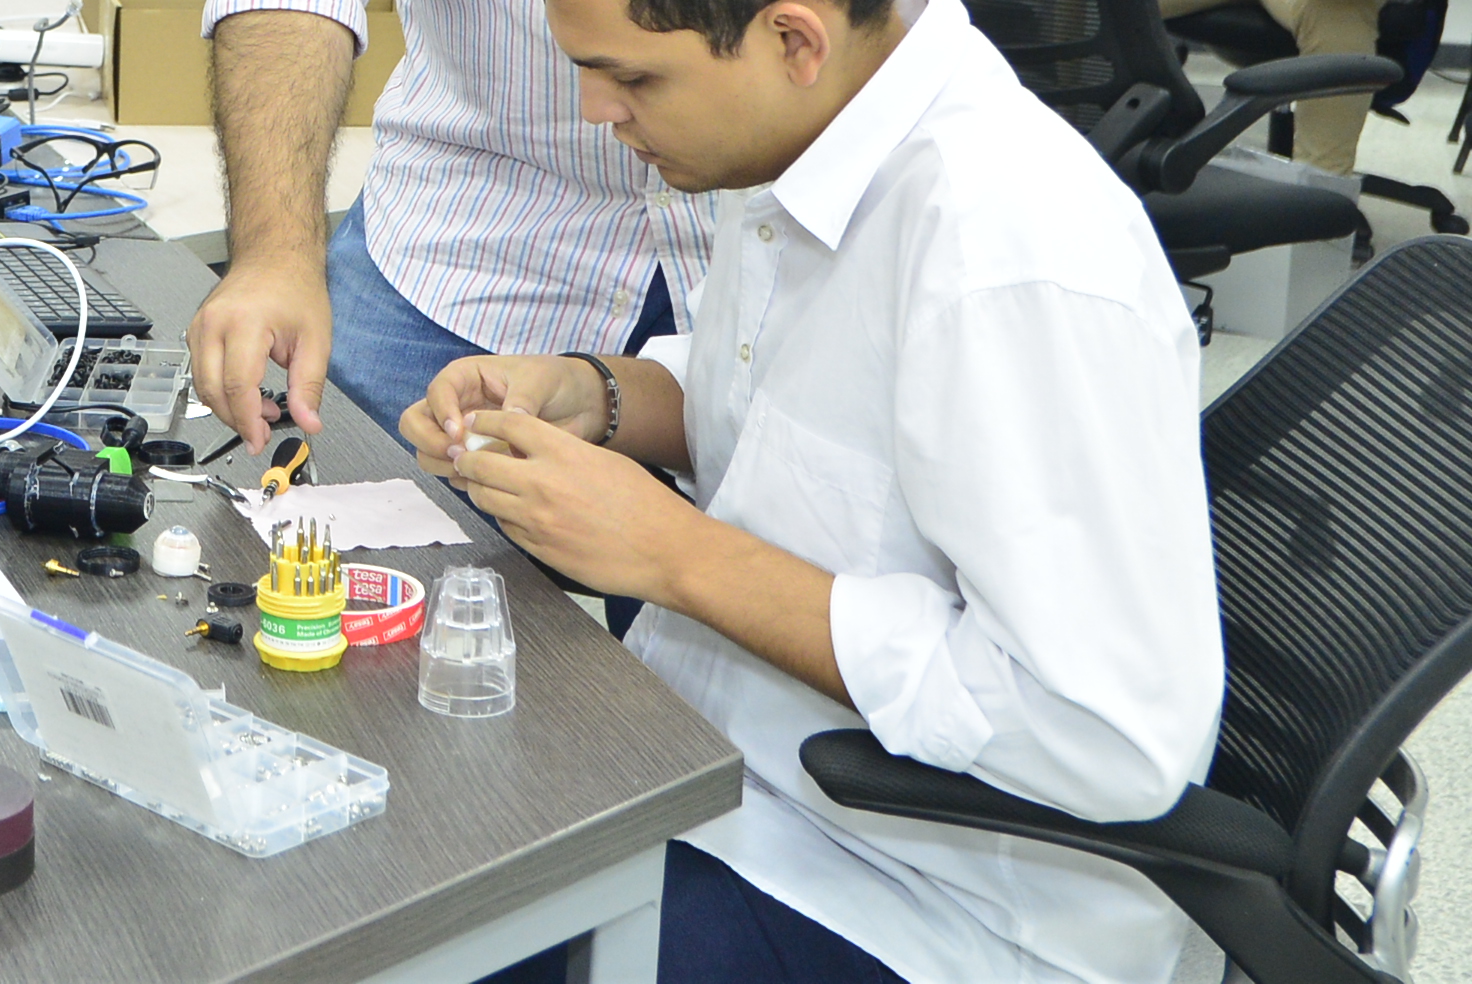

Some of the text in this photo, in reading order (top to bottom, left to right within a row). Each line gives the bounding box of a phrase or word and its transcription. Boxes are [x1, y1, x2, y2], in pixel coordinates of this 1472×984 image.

[353, 569, 383, 583] tesa
[353, 582, 383, 595] tesa
[296, 623, 326, 631] Precision
